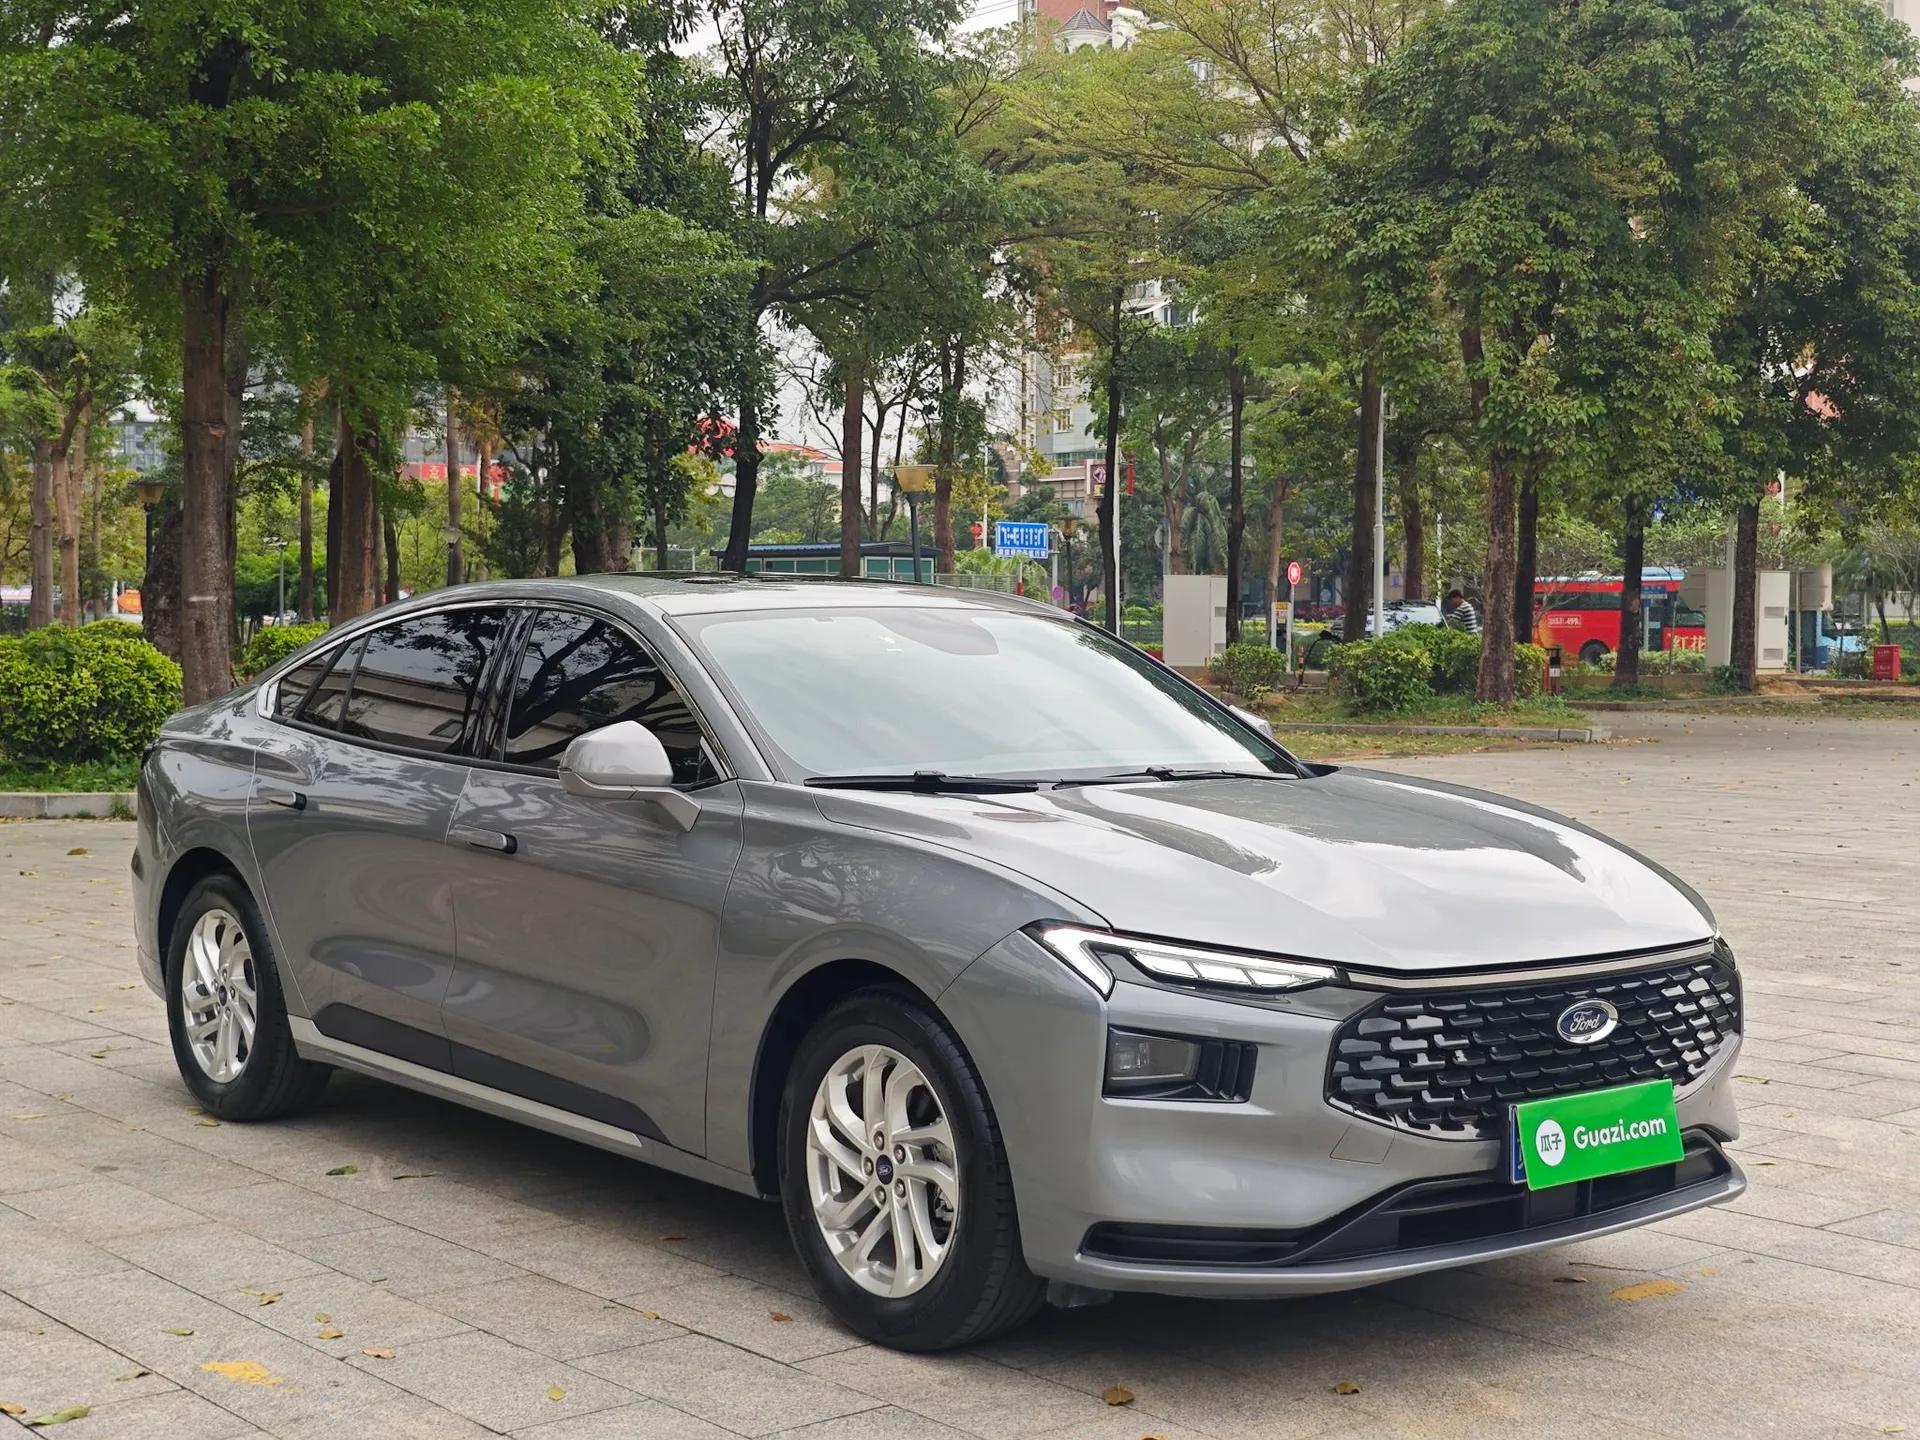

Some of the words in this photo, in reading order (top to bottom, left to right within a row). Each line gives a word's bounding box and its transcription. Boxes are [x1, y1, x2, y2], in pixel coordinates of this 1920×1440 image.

[1569, 1010, 1601, 1033] Ford
[1540, 1132, 1563, 1153] 瓜子
[1573, 1117, 1667, 1150] Guazi.com
